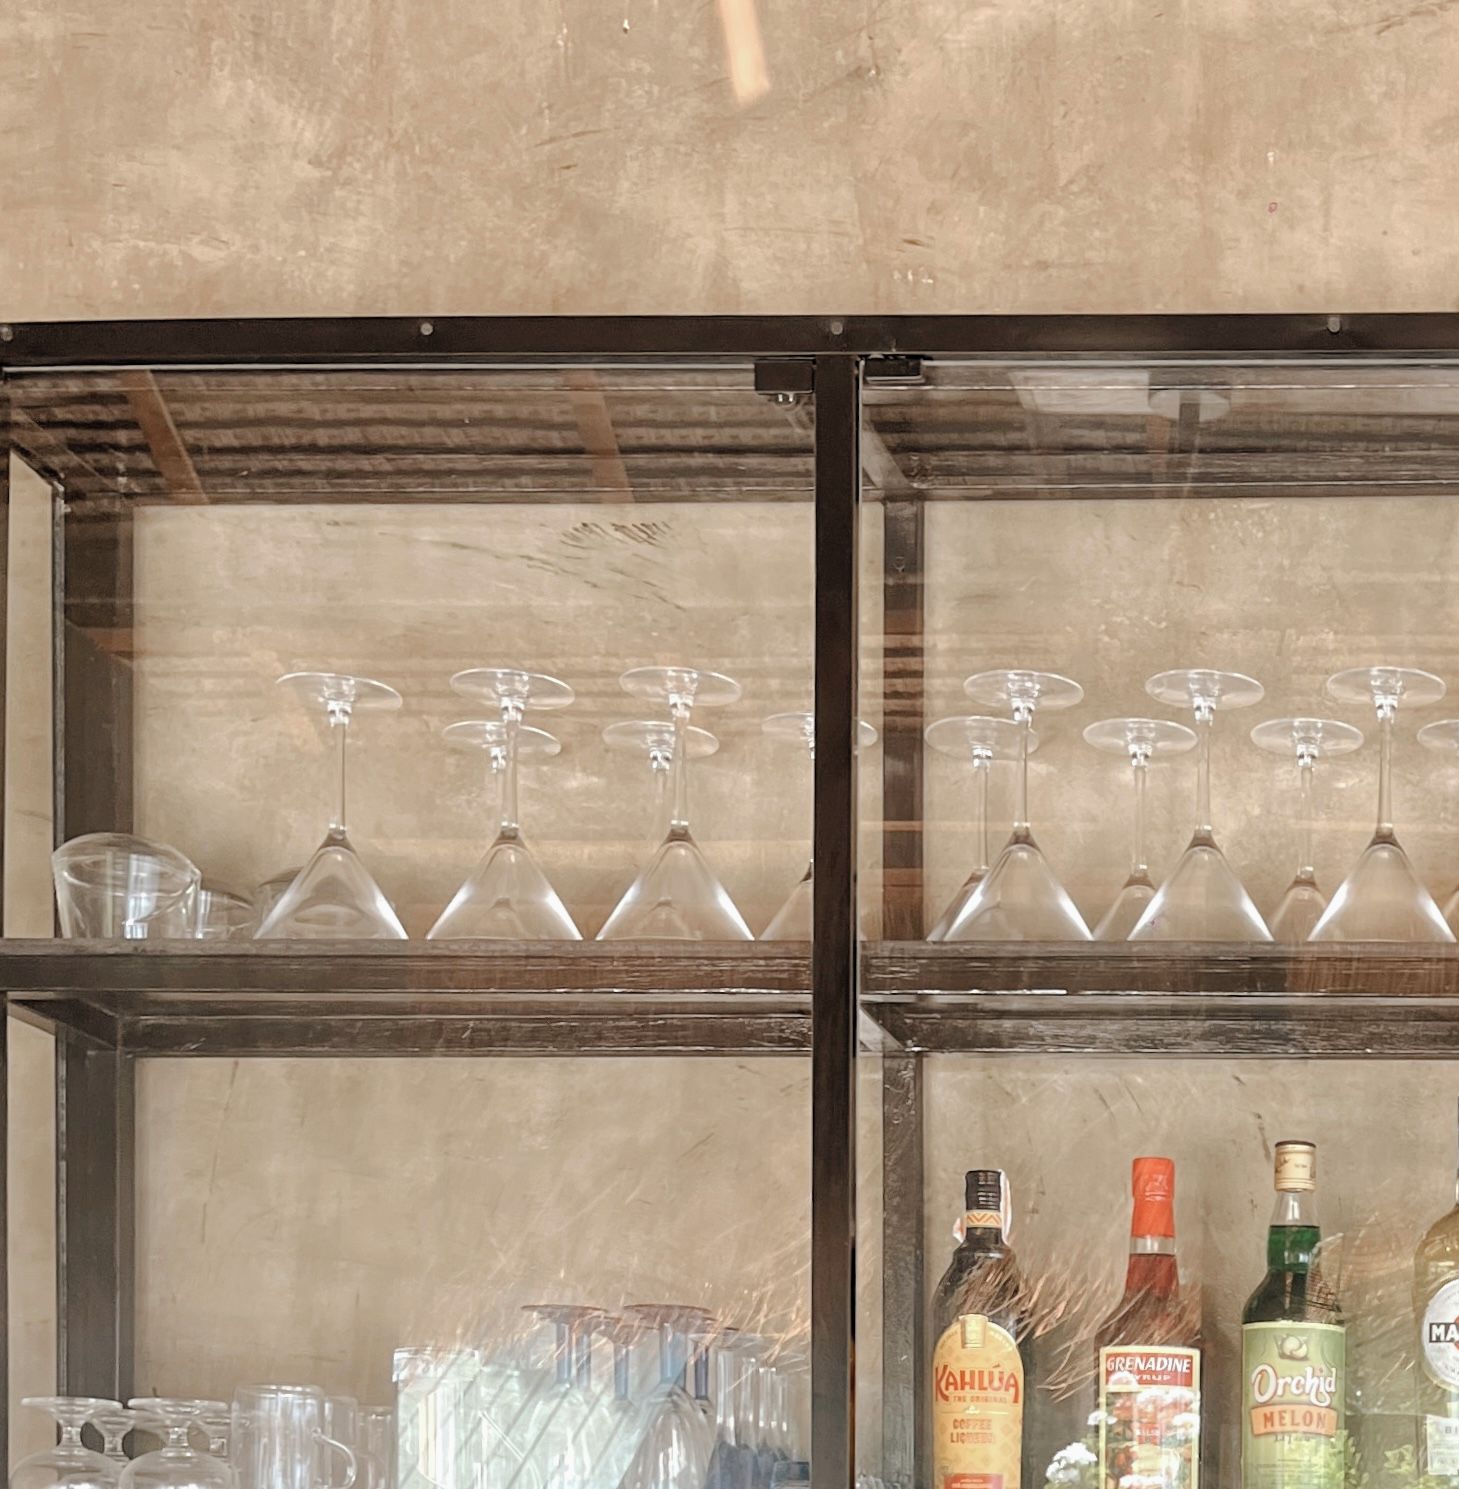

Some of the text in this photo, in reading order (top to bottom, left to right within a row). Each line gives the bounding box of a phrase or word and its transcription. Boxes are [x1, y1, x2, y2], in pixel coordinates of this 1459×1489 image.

[1106, 1356, 1192, 1373] GRENADINE
[935, 1363, 1019, 1404] KAHLÚA
[1251, 1363, 1337, 1407] Orchid
[1263, 1409, 1327, 1429] MELON
